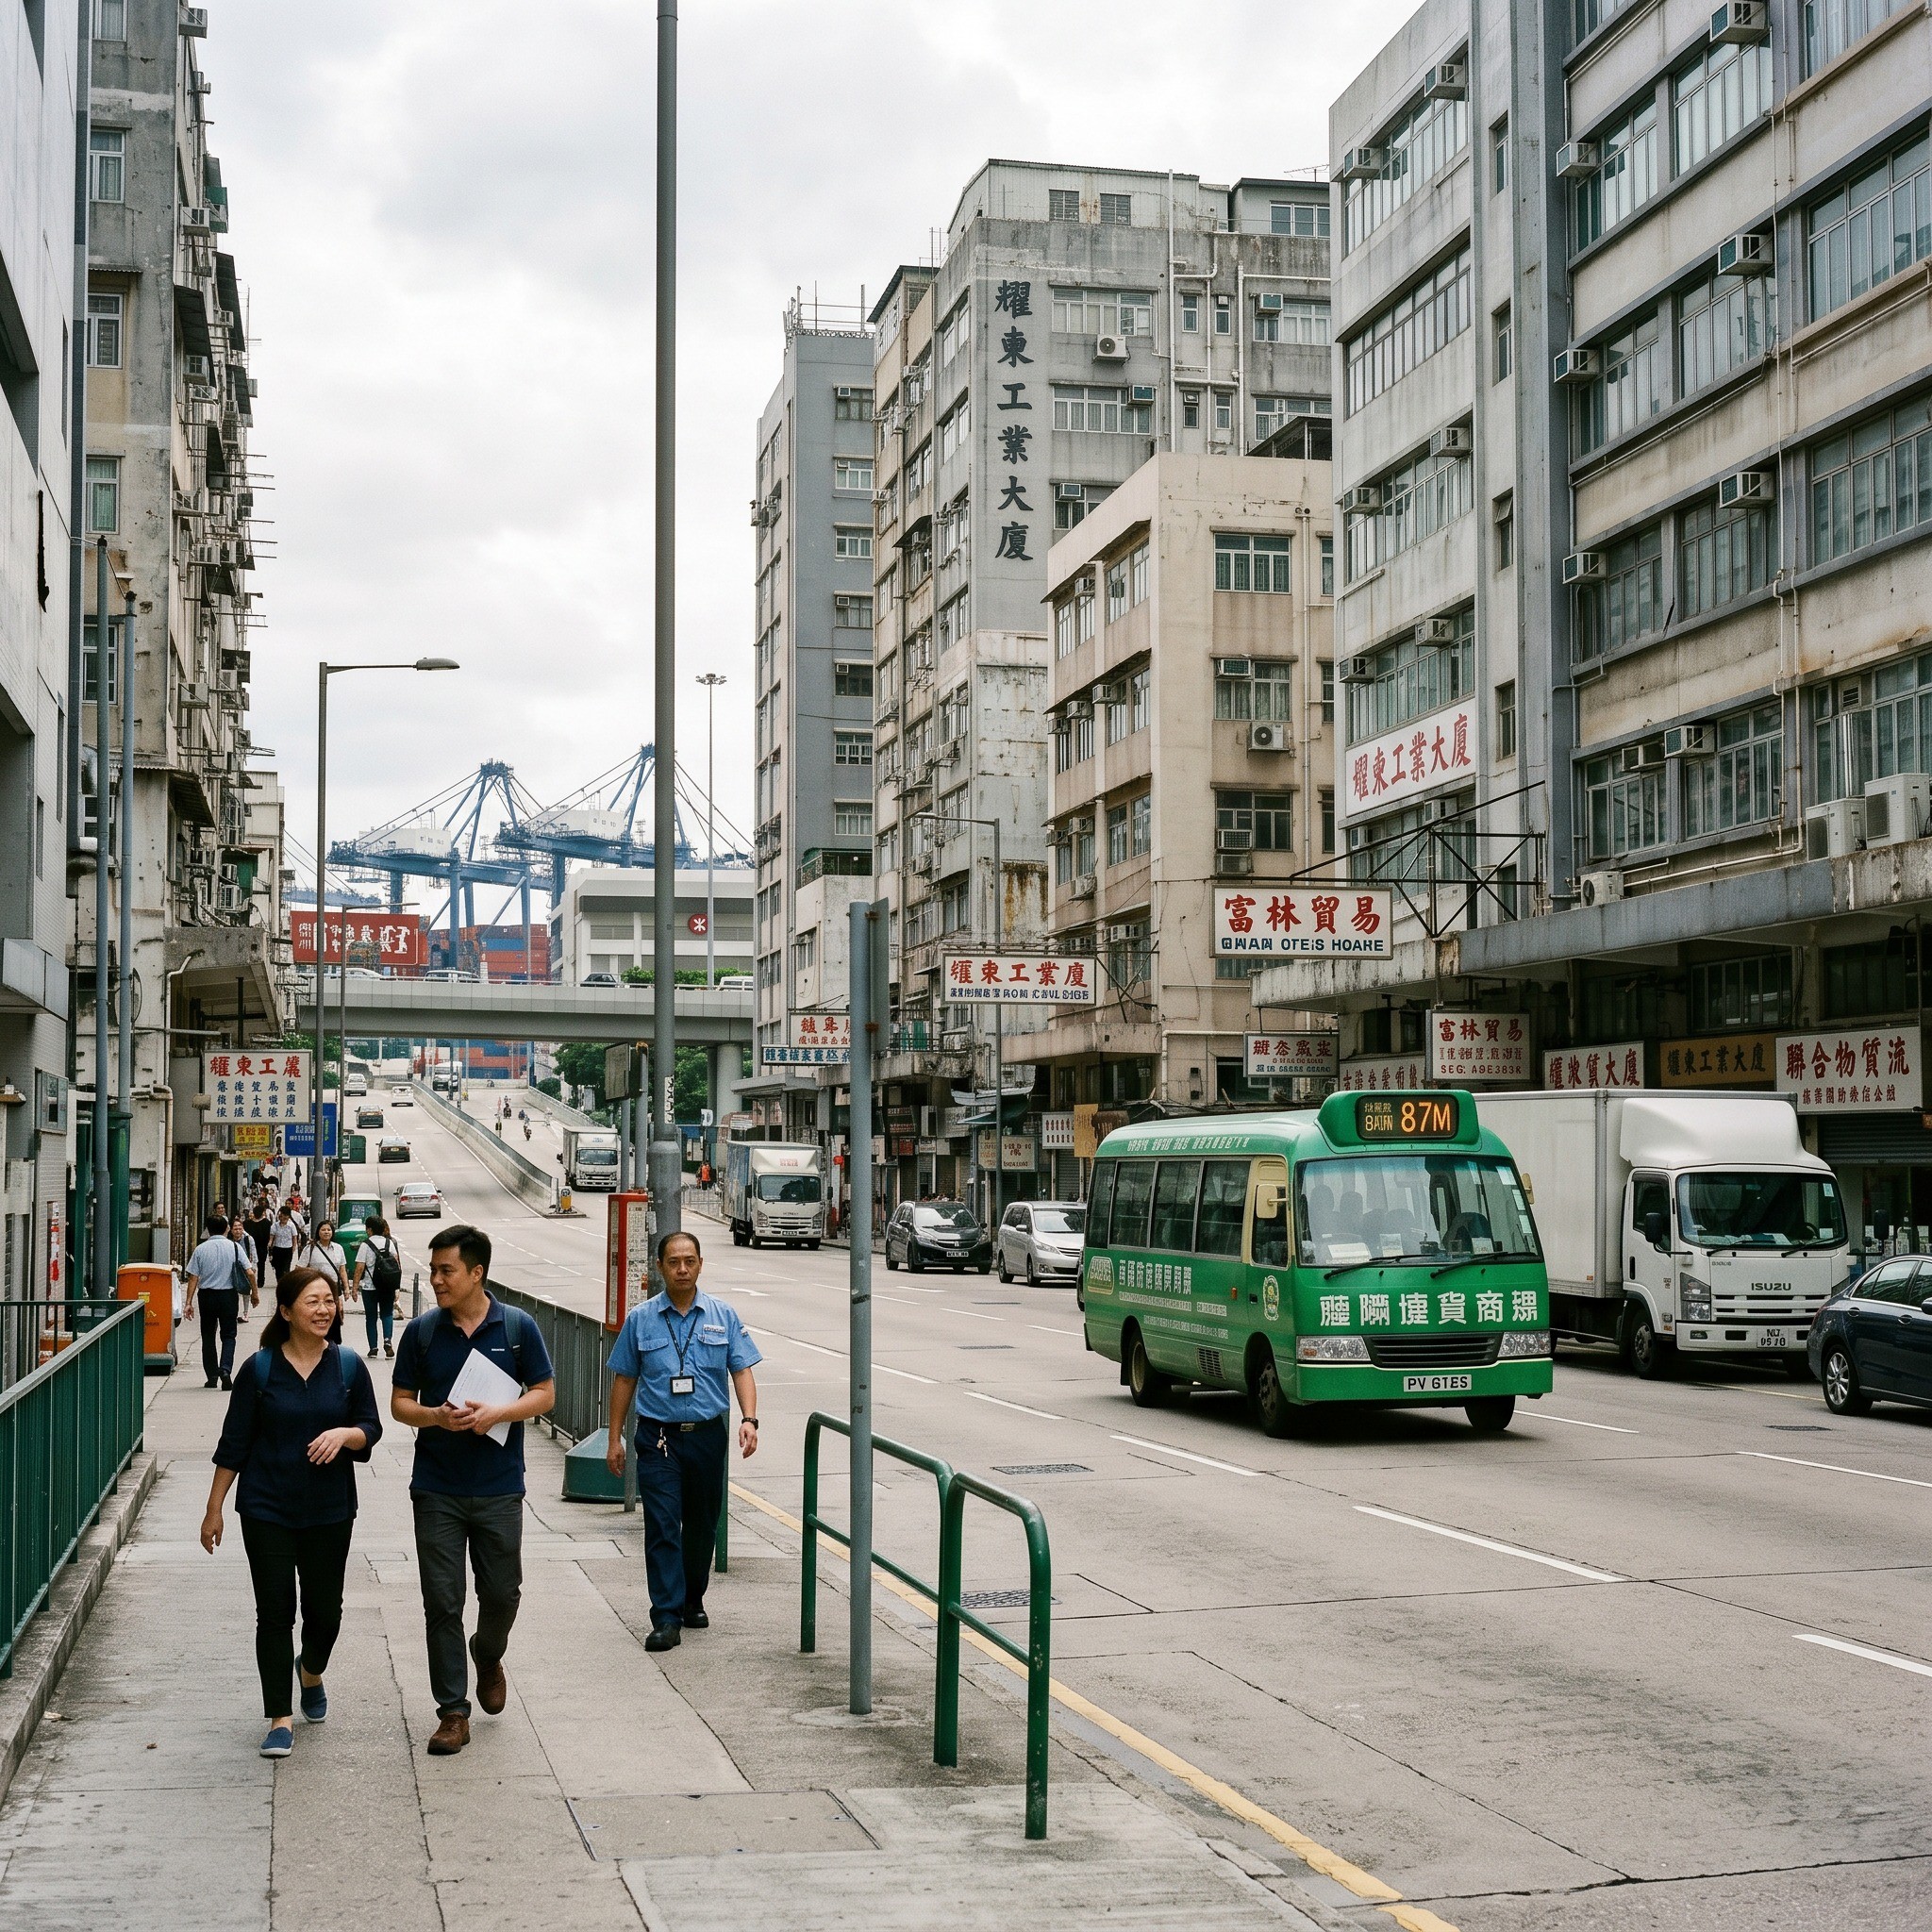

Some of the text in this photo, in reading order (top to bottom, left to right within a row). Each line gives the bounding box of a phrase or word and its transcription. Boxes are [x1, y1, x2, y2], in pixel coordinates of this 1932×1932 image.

[994, 280, 1034, 560] 耀東工業大廈
[1224, 894, 1380, 934] 富林貿易
[1439, 1018, 1523, 1042] 富林貿易
[1786, 1035, 1909, 1081] 聯合物質流
[1401, 1102, 1451, 1133] 87M
[1751, 1282, 1791, 1291] ISUZU
[1407, 1376, 1426, 1391] PV
